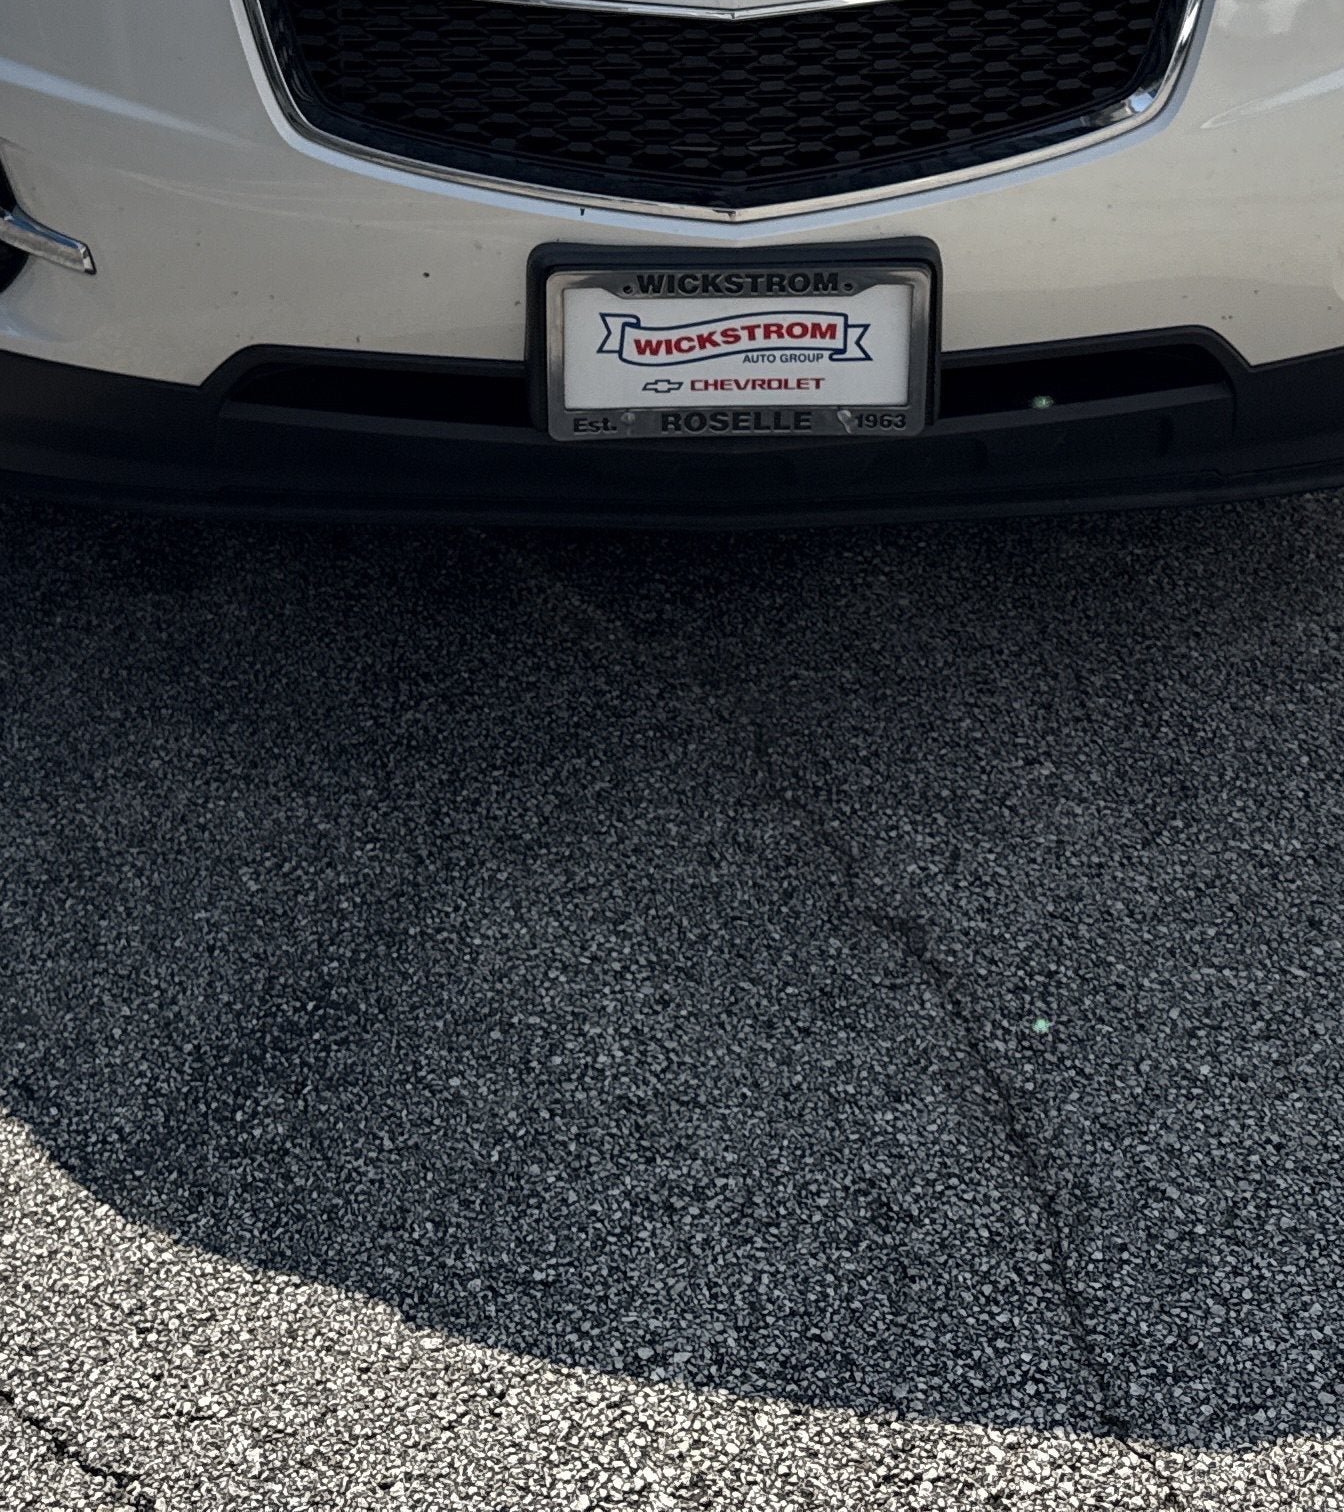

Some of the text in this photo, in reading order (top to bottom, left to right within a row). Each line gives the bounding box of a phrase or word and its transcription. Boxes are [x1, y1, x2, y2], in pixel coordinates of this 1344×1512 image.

[636, 272, 840, 295] WICKSTROM
[633, 322, 838, 356] WICKSTROM
[742, 352, 824, 364] AUTO GROUP
[690, 378, 825, 392] CHEVROLET
[573, 411, 907, 434] Est. ROSELLE 1963
